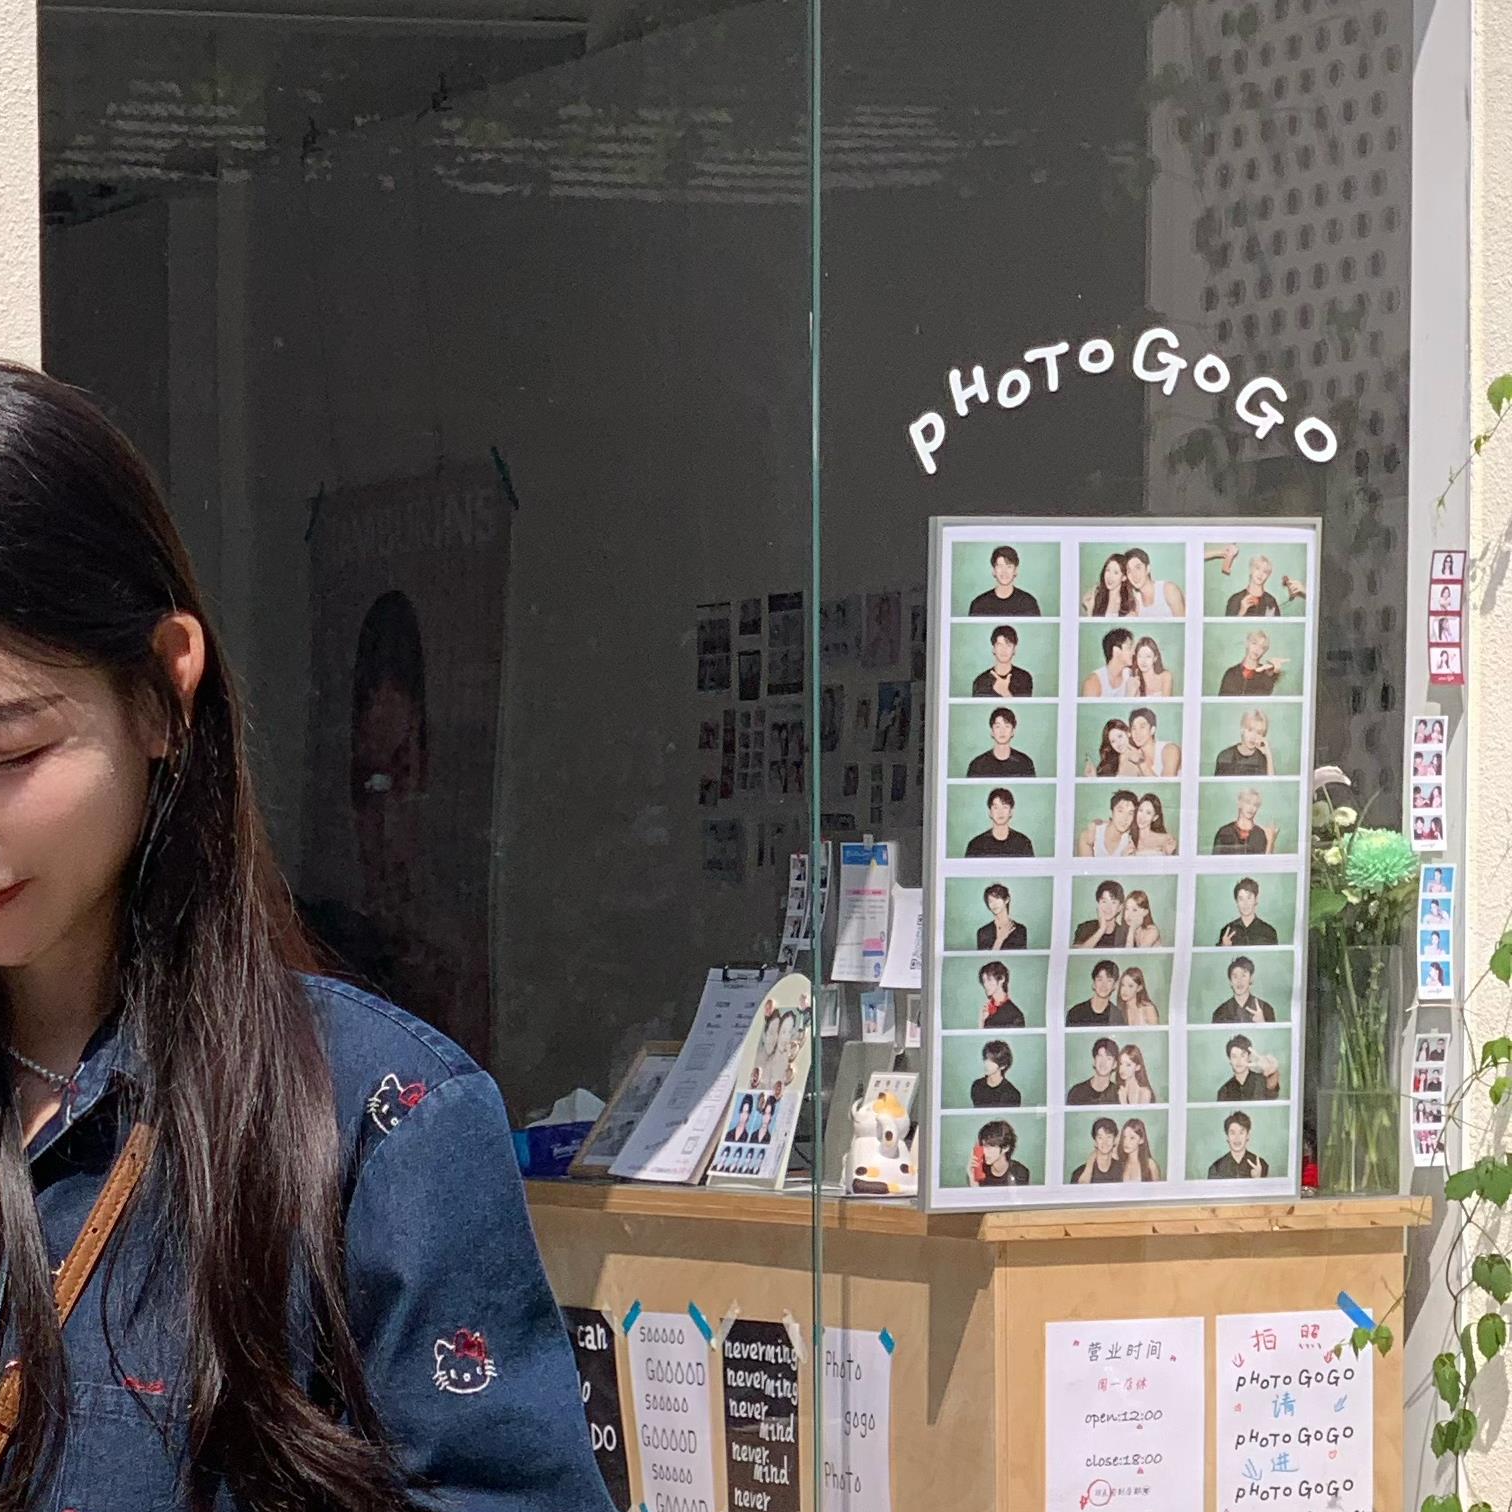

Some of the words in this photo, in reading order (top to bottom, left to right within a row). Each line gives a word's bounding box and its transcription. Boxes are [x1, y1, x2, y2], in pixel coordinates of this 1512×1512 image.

[1088, 1339, 1163, 1362] 营业时间
[729, 1398, 768, 1421] never
[1271, 1392, 1297, 1418] 请
[759, 1413, 795, 1443] mind
[753, 1455, 790, 1485] mind
[1271, 1451, 1300, 1473] 进
[734, 1487, 771, 1512] never
